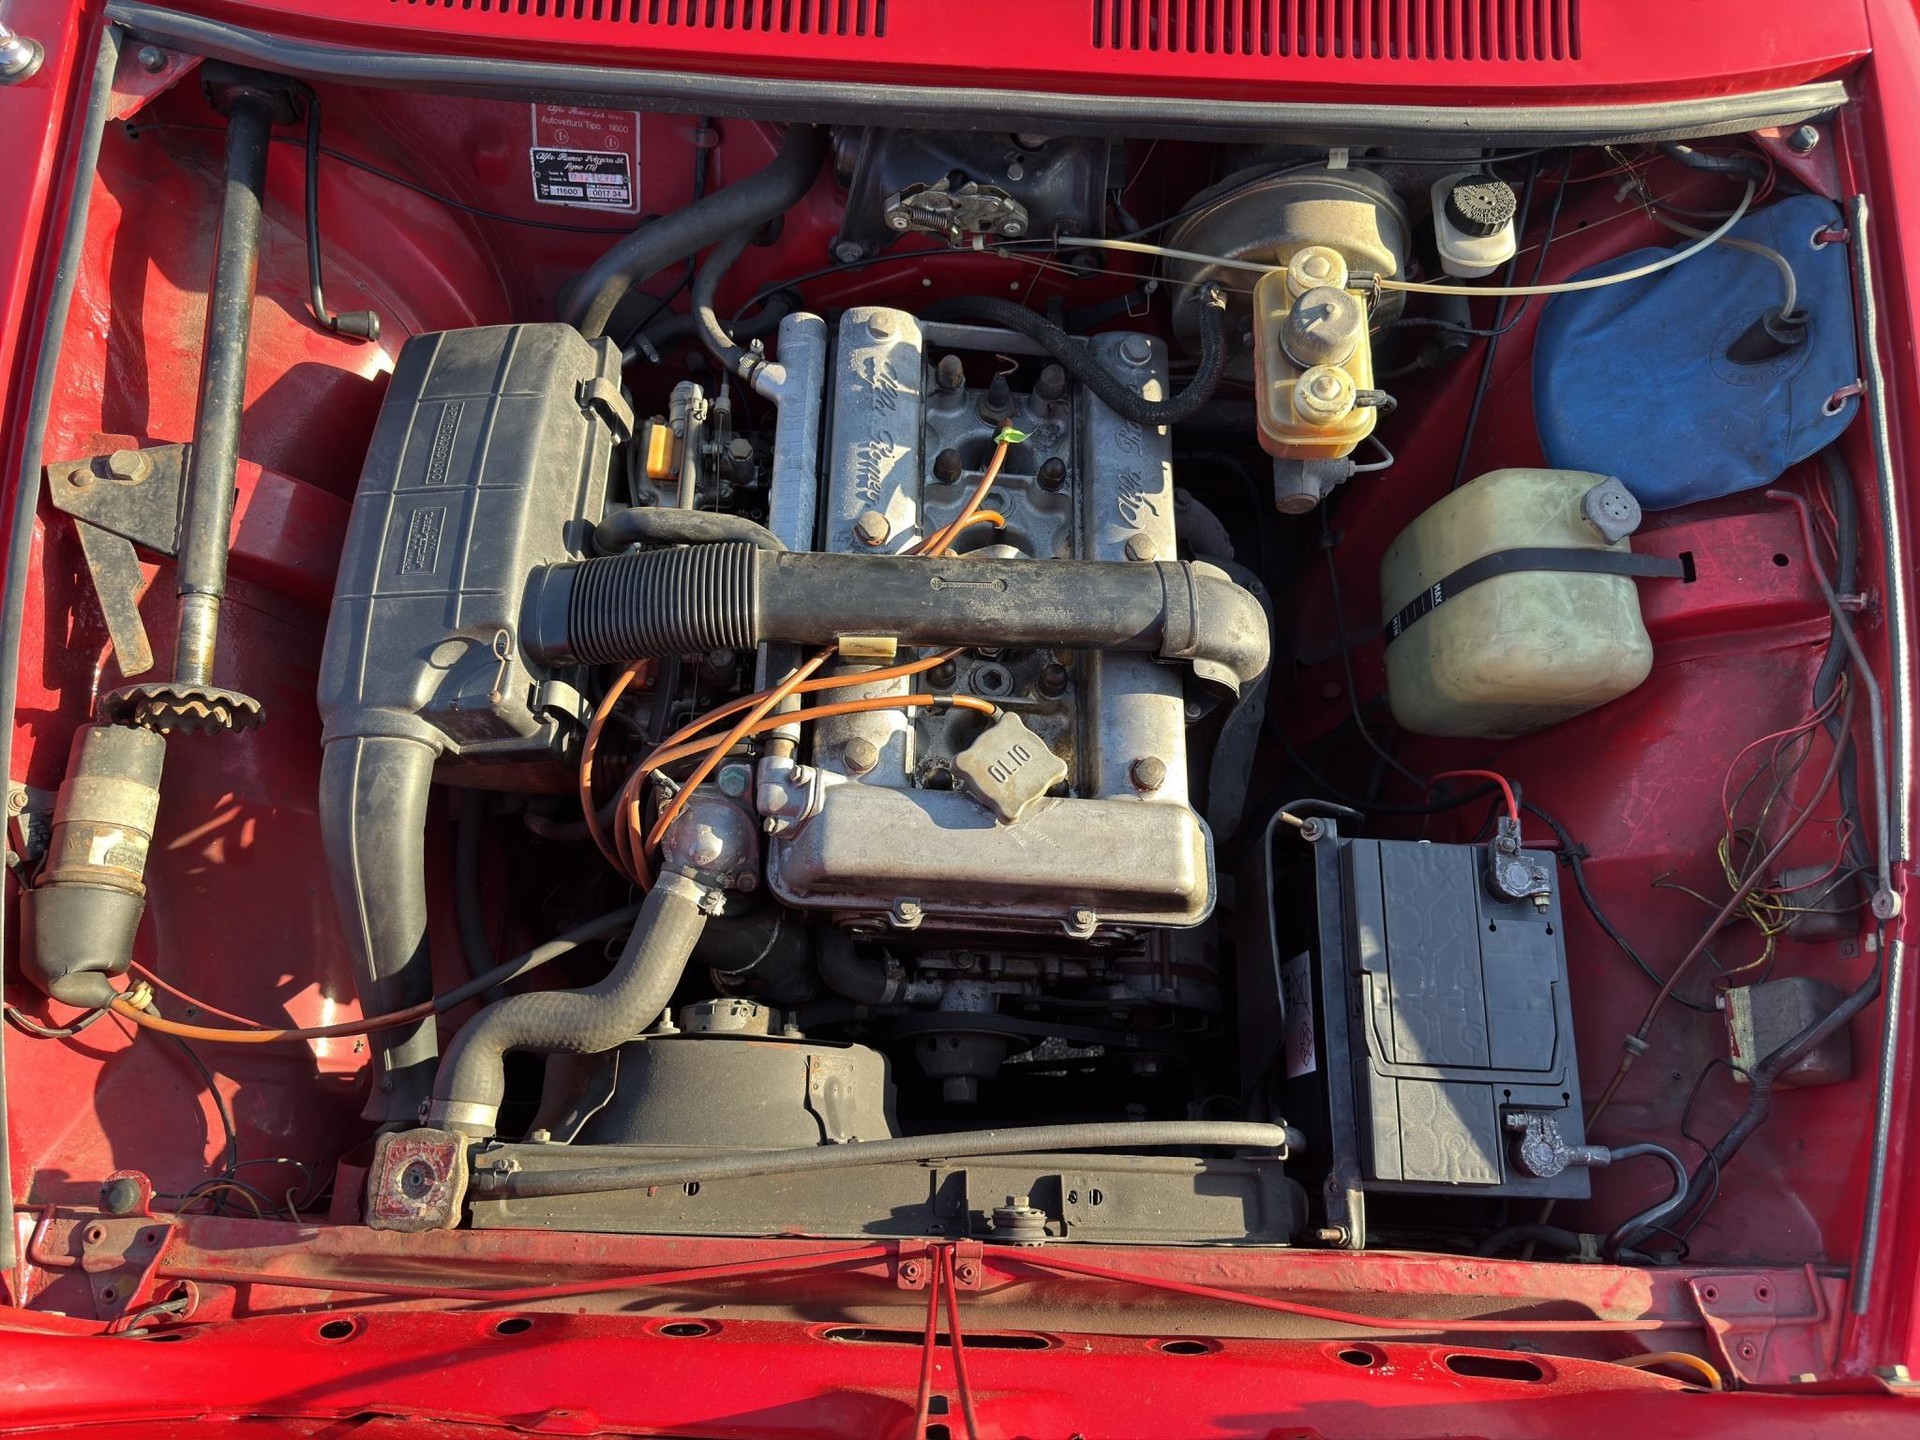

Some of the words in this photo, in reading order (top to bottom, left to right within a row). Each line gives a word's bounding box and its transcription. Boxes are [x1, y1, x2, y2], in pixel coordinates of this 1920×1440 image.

[541, 115, 583, 129] Autovettura
[536, 152, 556, 164] Alfa
[556, 152, 583, 163] Romeo
[556, 187, 578, 196] 11600
[1433, 582, 1443, 606] MAX
[1391, 616, 1400, 638] MIN
[987, 743, 1032, 784] OLIO
